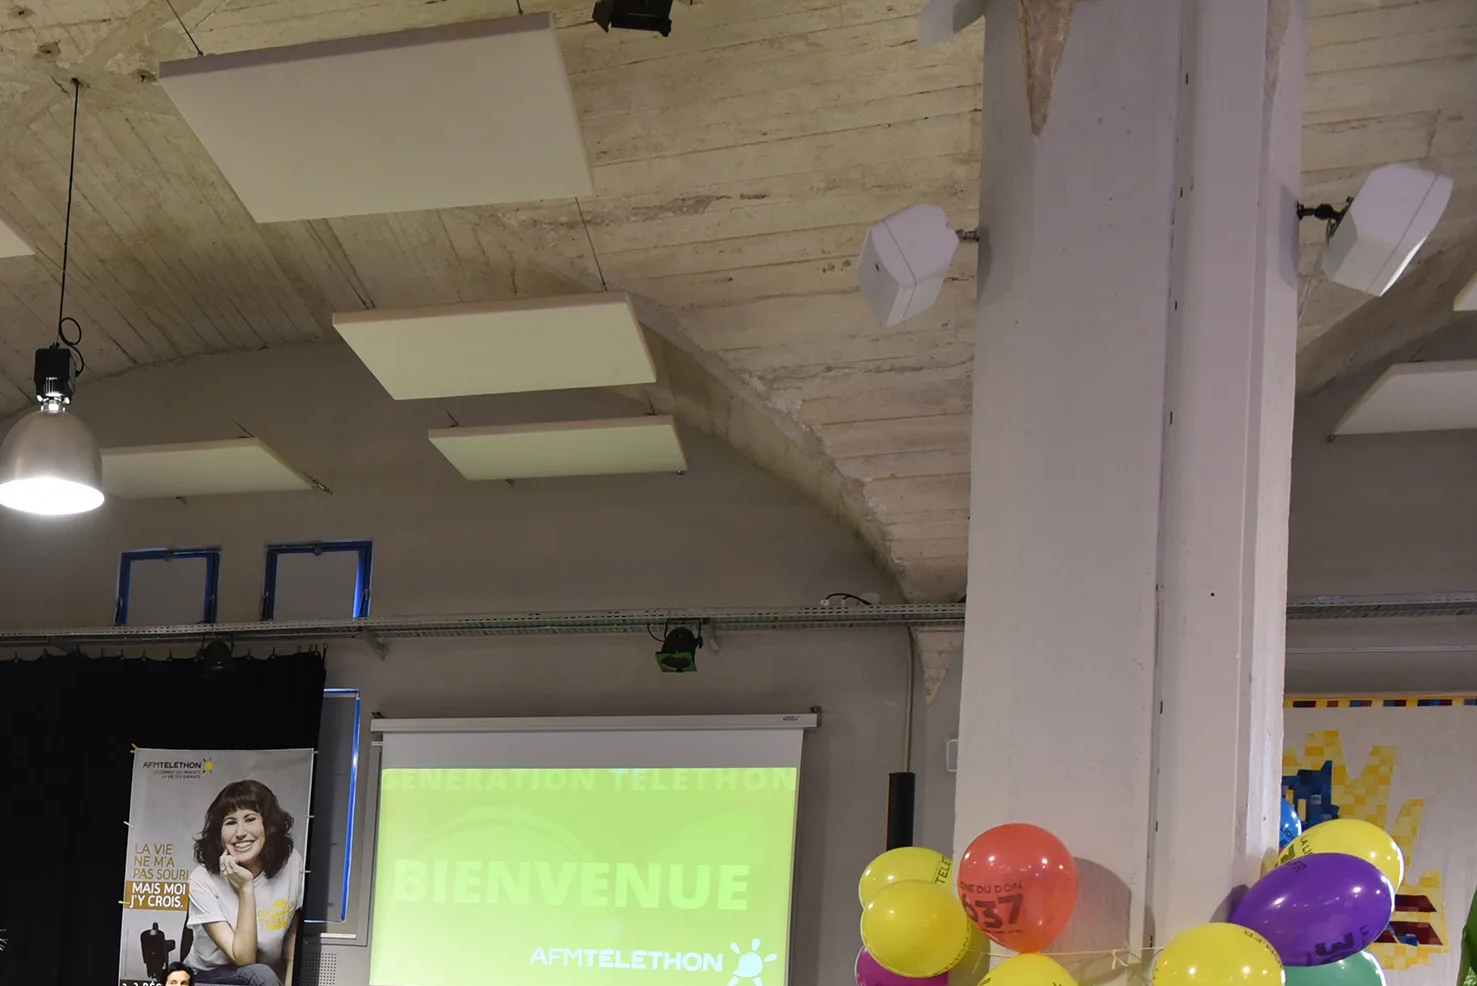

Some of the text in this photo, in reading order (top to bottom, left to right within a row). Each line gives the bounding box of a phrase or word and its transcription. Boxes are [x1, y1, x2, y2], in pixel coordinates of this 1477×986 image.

[135, 843, 173, 855] LA VIE
[134, 856, 175, 868] NE M'A
[133, 868, 154, 880] PAS
[132, 882, 186, 895] MAIS MOI
[392, 859, 751, 910] BIENVENUE
[976, 885, 992, 894] DU
[994, 881, 1022, 894] DON
[129, 894, 184, 909] J'Y CROIS.
